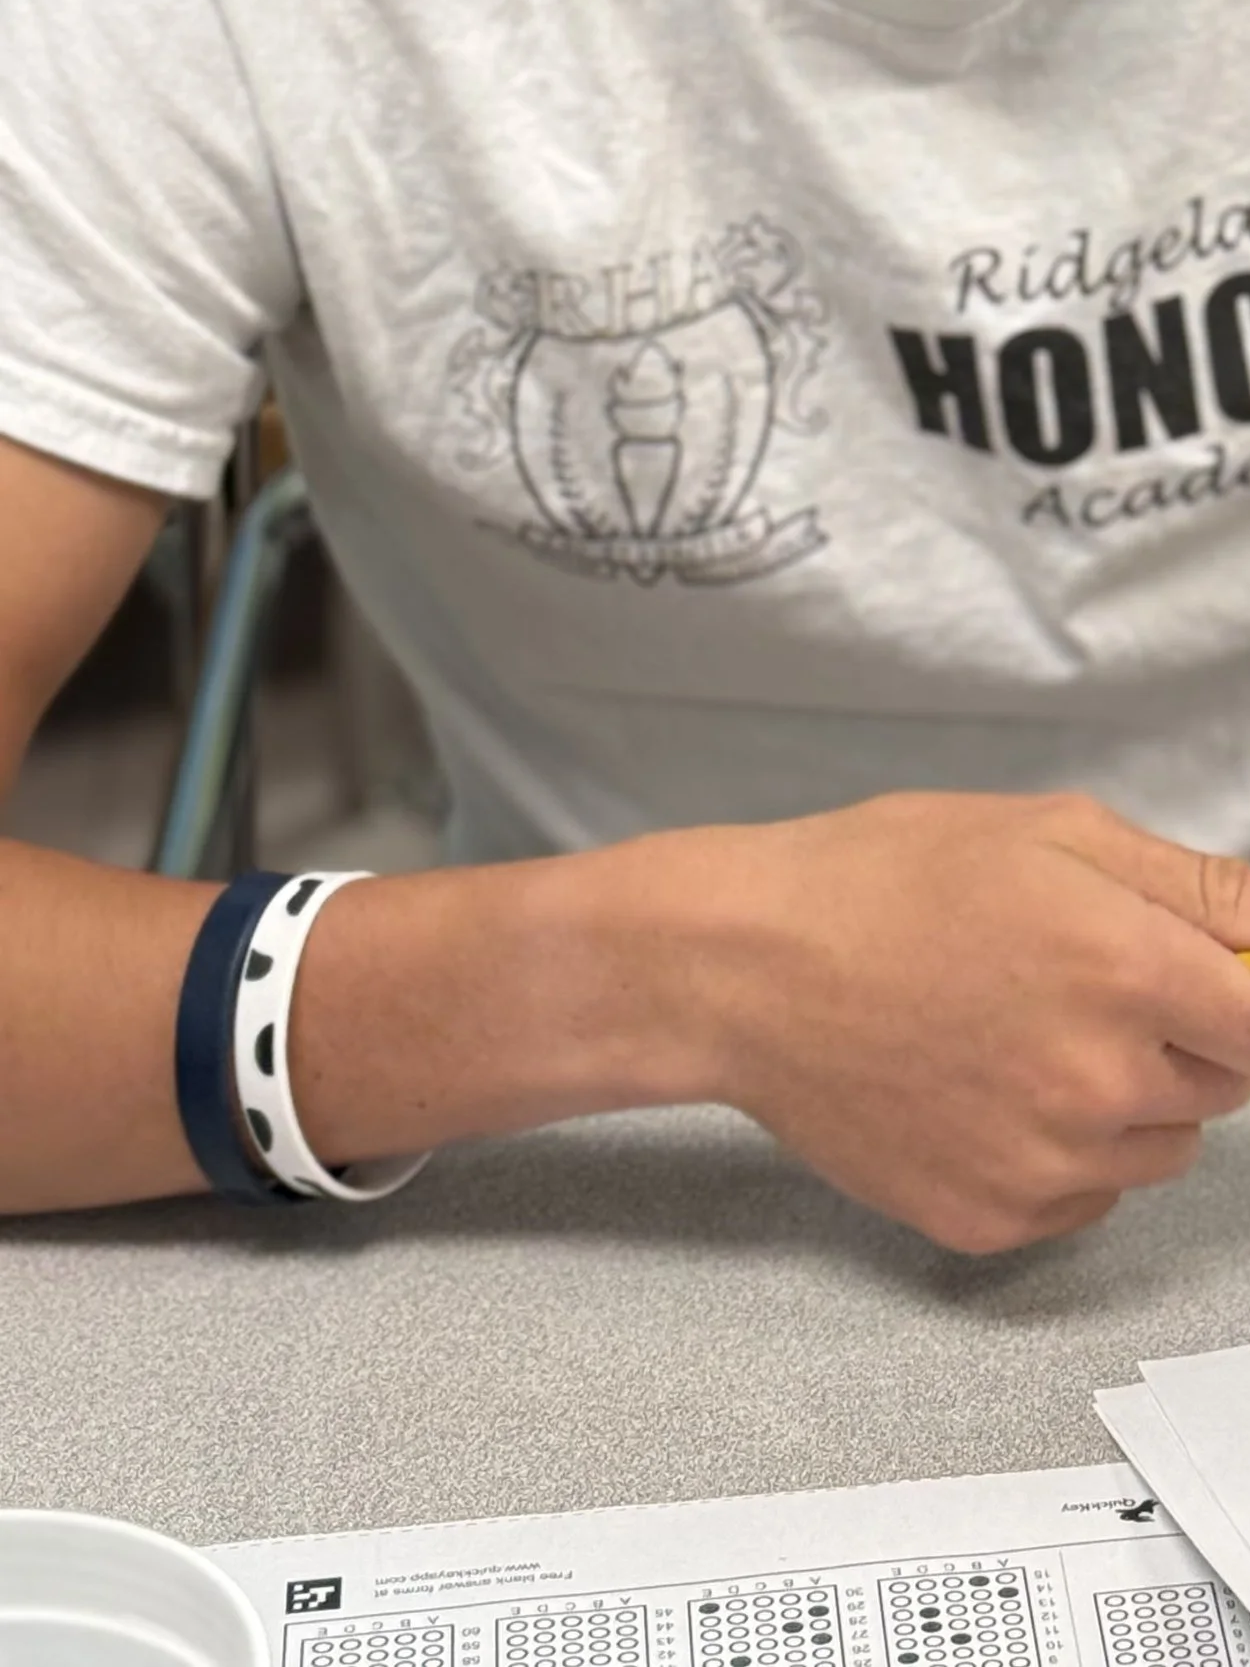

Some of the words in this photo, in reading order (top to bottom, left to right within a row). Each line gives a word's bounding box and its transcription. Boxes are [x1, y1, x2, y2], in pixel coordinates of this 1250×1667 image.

[943, 1562, 956, 1573] C
[971, 1561, 983, 1571] B
[996, 1557, 1009, 1569] A
[374, 1562, 542, 1586] www.quickkeyapp.com
[539, 1569, 573, 1581] Free
[891, 1566, 902, 1578] E
[916, 1564, 929, 1576] D
[1033, 1569, 1051, 1580] 15
[437, 1577, 492, 1592] answer
[495, 1573, 536, 1586] blank
[782, 1578, 794, 1590] B
[809, 1576, 822, 1586] A
[392, 1584, 435, 1596] forms
[727, 1584, 740, 1596] D
[754, 1581, 768, 1593] C
[845, 1586, 864, 1598] 30
[1036, 1582, 1053, 1594] 14
[374, 1588, 389, 1599] at
[702, 1588, 713, 1599] E
[564, 1601, 577, 1612] C
[592, 1599, 604, 1610] B
[619, 1596, 632, 1606] A
[846, 1600, 865, 1612] 29
[1038, 1597, 1056, 1608] 13
[510, 1606, 521, 1616] E
[536, 1603, 549, 1615] D
[654, 1608, 674, 1619] 45
[426, 1615, 440, 1626] A
[848, 1615, 868, 1626] 28
[1040, 1611, 1059, 1622] 12
[1230, 1613, 1240, 1625] 7
[343, 1623, 356, 1634] D
[371, 1621, 384, 1631] C
[399, 1618, 412, 1629] B
[656, 1621, 675, 1632] 44
[318, 1626, 328, 1638] E
[461, 1626, 481, 1638] 60
[851, 1628, 869, 1641] 27
[1044, 1624, 1060, 1636] 11
[461, 1640, 481, 1652] 59
[655, 1636, 675, 1646] 43
[1045, 1640, 1064, 1651] 10
[851, 1643, 871, 1655] 26
[1235, 1642, 1246, 1654] 5
[657, 1649, 677, 1660] 42
[461, 1655, 481, 1667] 58
